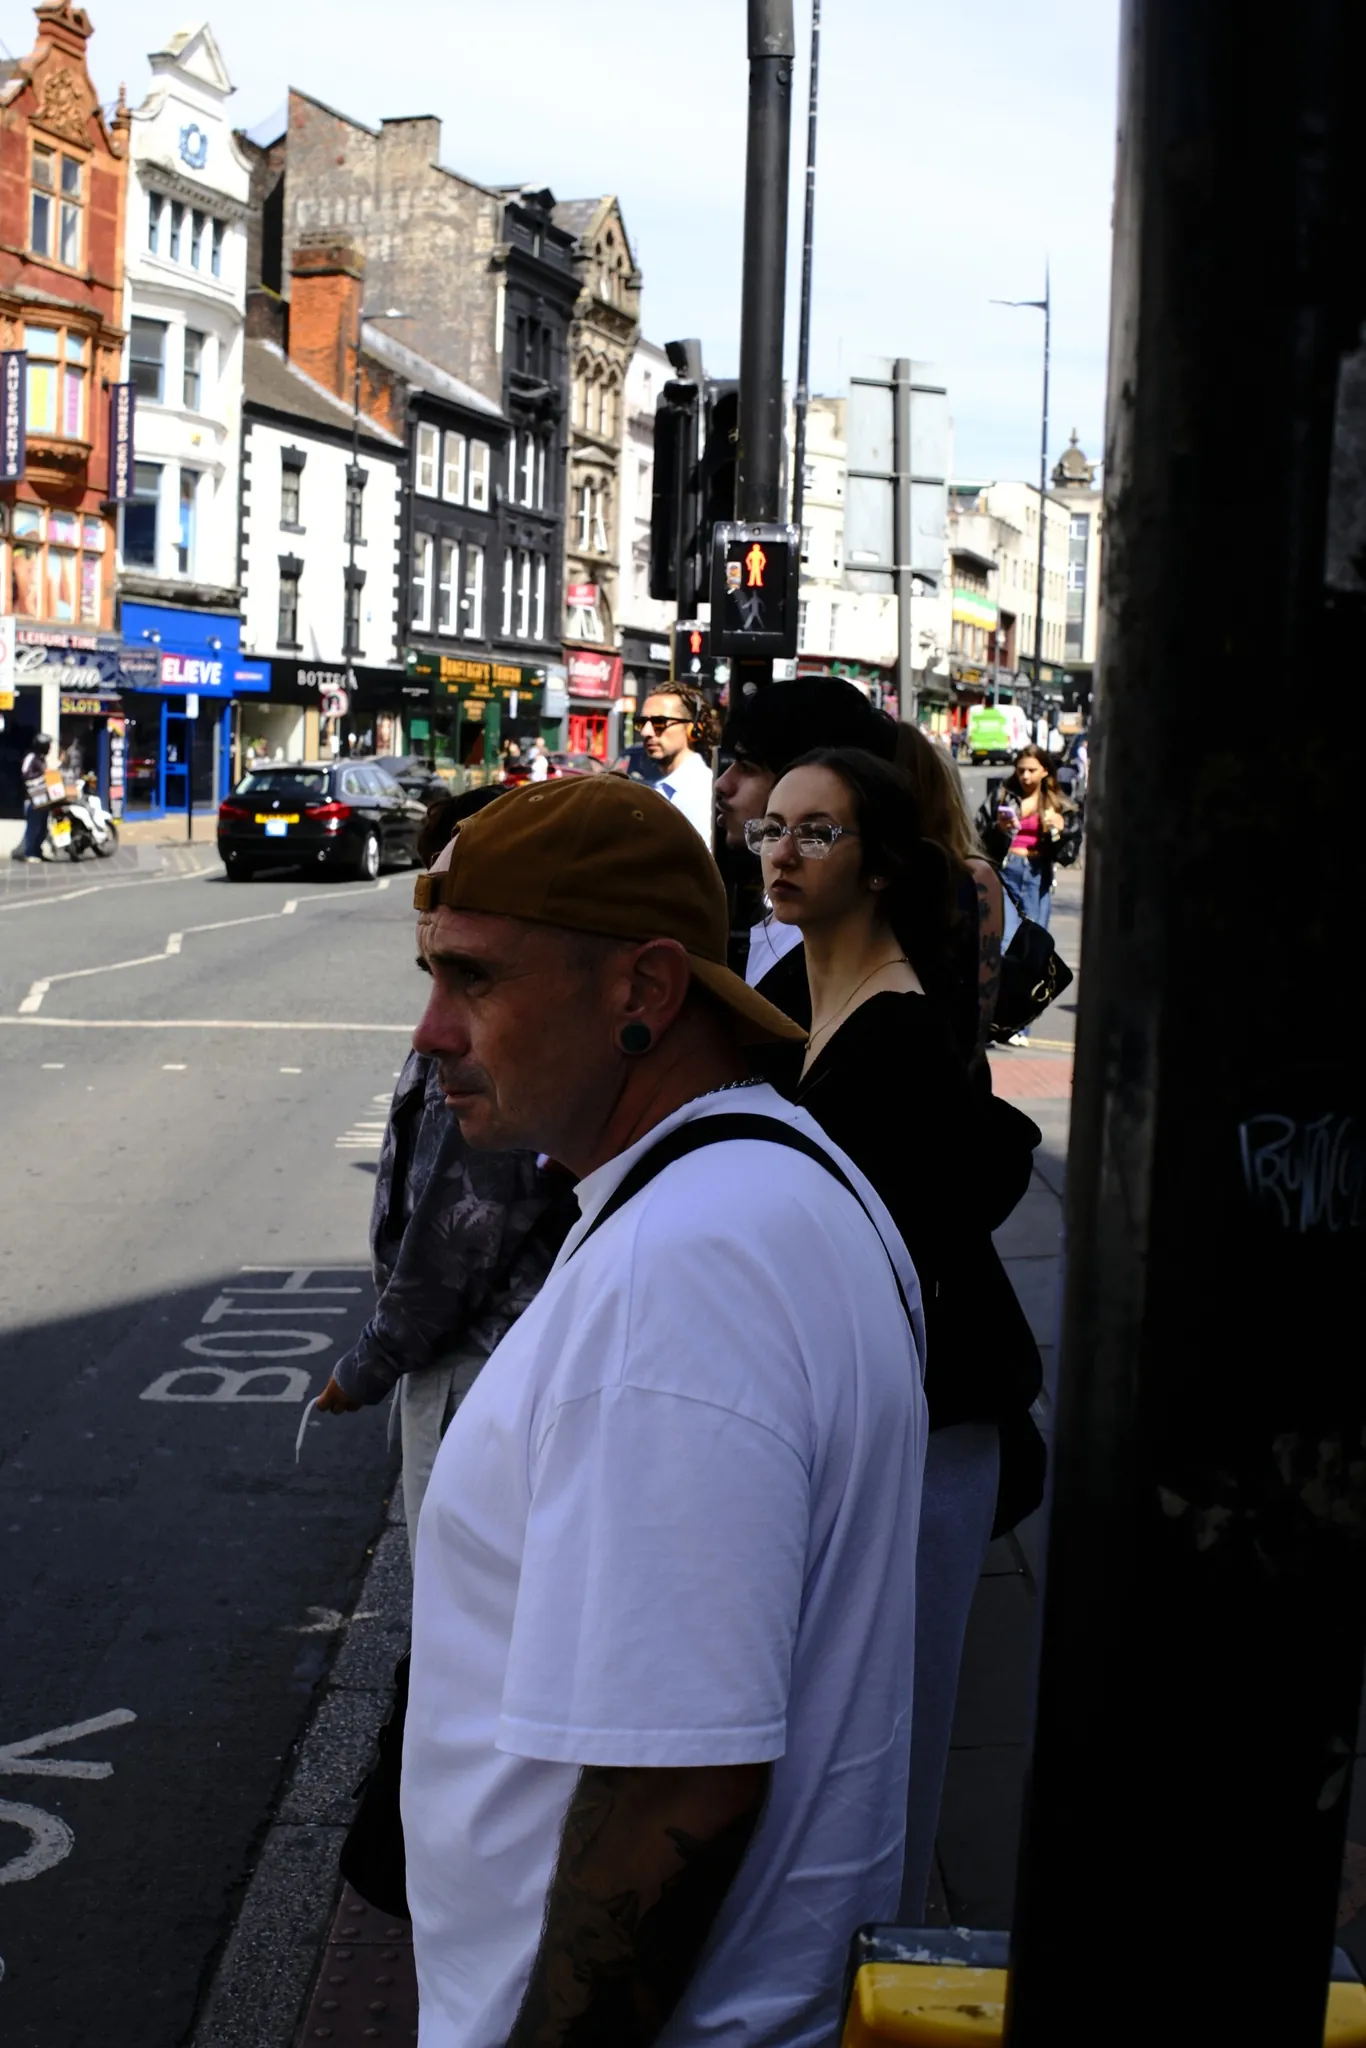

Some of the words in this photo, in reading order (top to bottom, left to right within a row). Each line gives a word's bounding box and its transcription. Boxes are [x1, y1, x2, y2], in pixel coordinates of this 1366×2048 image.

[6, 354, 19, 476] AMUSEMENTS
[18, 630, 68, 648] LEISURE
[71, 636, 97, 651] TIME
[162, 656, 223, 686] ELIEVE
[62, 696, 102, 714] SLOTS
[139, 1265, 366, 1404] BOTH
